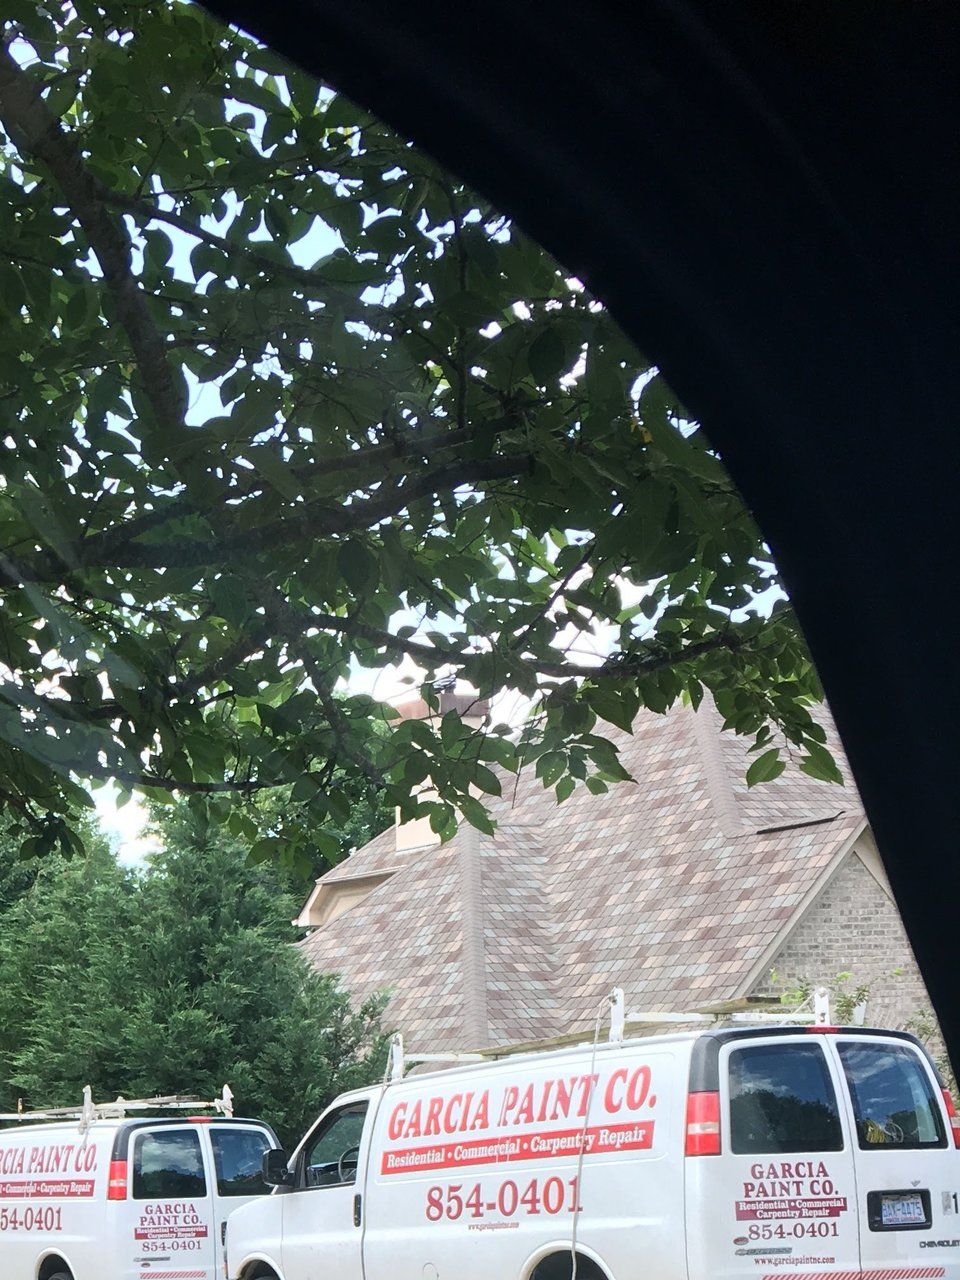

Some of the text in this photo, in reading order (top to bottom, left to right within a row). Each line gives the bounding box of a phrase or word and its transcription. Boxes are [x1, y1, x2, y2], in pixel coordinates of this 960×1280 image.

[388, 1064, 657, 1141] GARCIA PAINT CO.
[386, 1127, 646, 1169] Residential Commercial Carpentry Repair
[27, 1145, 75, 1174] PAINT
[75, 1143, 97, 1172] CO.
[750, 1161, 829, 1180] GARCIA
[40, 1182, 70, 1195] Carpentry
[70, 1181, 93, 1195] Repair
[743, 1179, 839, 1198] PAINT CO.
[425, 1175, 583, 1222] 854-0401
[739, 1198, 844, 1211] Residential Commercial
[144, 1203, 197, 1215] GARCIA
[756, 1208, 830, 1219] Carpentry Repair
[139, 1214, 202, 1226] PAINT CO.
[748, 1222, 839, 1241] 854-0401
[141, 1240, 202, 1252] 854-0401
